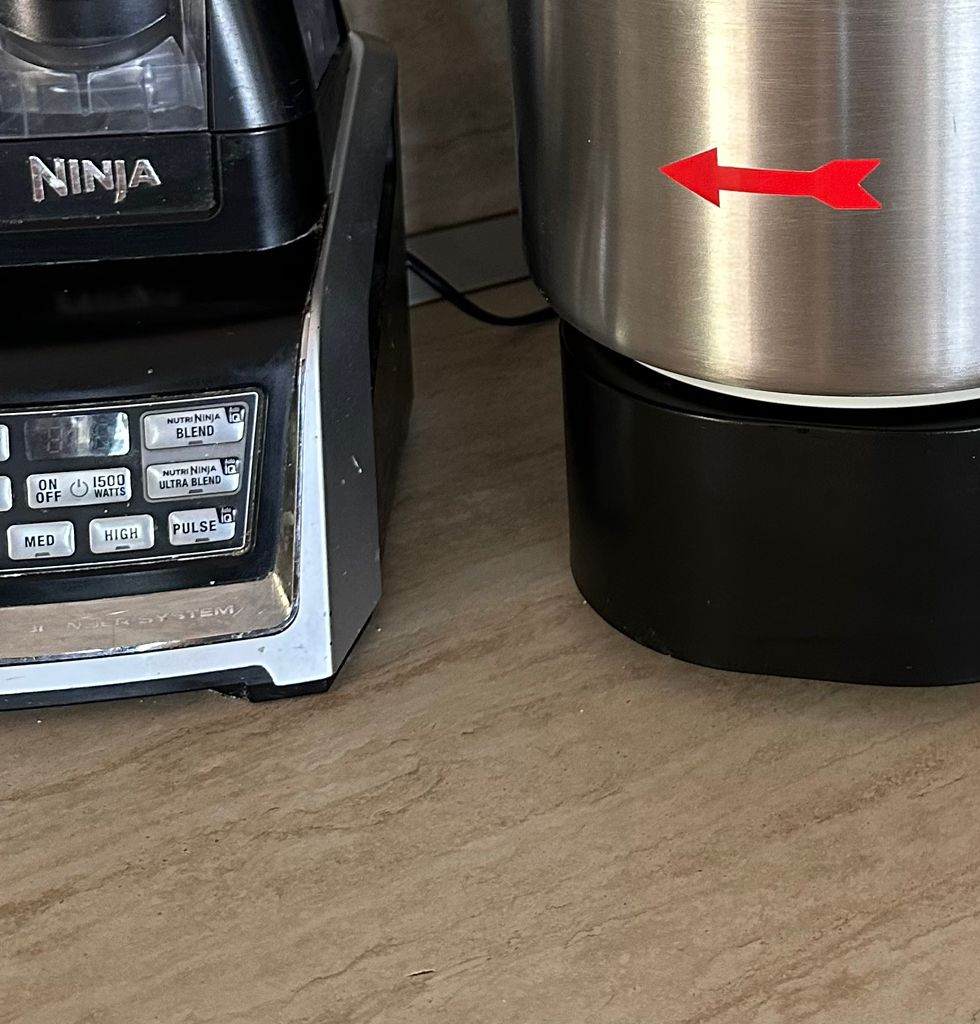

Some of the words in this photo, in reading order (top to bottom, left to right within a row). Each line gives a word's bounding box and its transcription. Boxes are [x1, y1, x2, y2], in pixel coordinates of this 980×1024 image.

[28, 155, 162, 204] NINJA
[194, 413, 221, 423] NINJA
[176, 425, 215, 439] BLEND
[163, 469, 189, 477] NUTRI
[190, 465, 217, 475] NINJA
[38, 478, 57, 491] ON
[93, 474, 126, 488] 1500
[159, 478, 189, 490] ULTRA
[191, 475, 222, 487] BLEND
[35, 491, 62, 504] OFF
[94, 486, 126, 498] WATTS
[104, 527, 138, 542] HIGH
[173, 520, 217, 535] PULSE
[24, 534, 55, 548] MED
